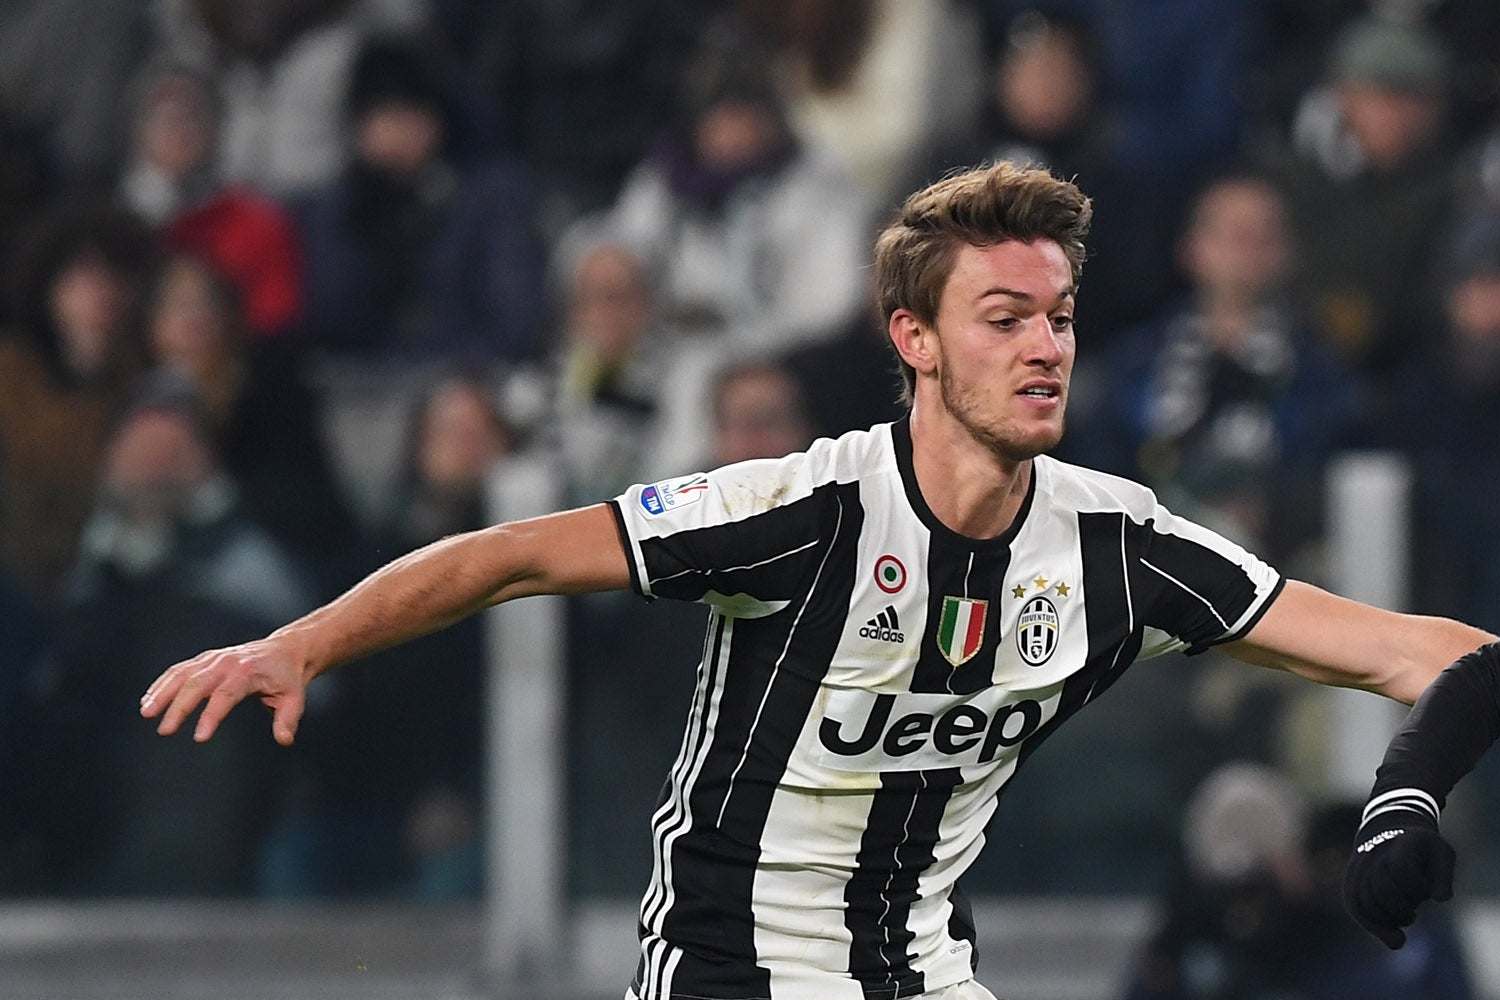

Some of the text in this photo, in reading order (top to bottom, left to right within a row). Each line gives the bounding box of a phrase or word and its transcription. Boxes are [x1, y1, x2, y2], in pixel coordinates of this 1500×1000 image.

[646, 495, 660, 512] TIM
[1021, 613, 1055, 624] JUVENTUS
[859, 626, 905, 643] adidas
[819, 694, 1042, 764] Jeep
